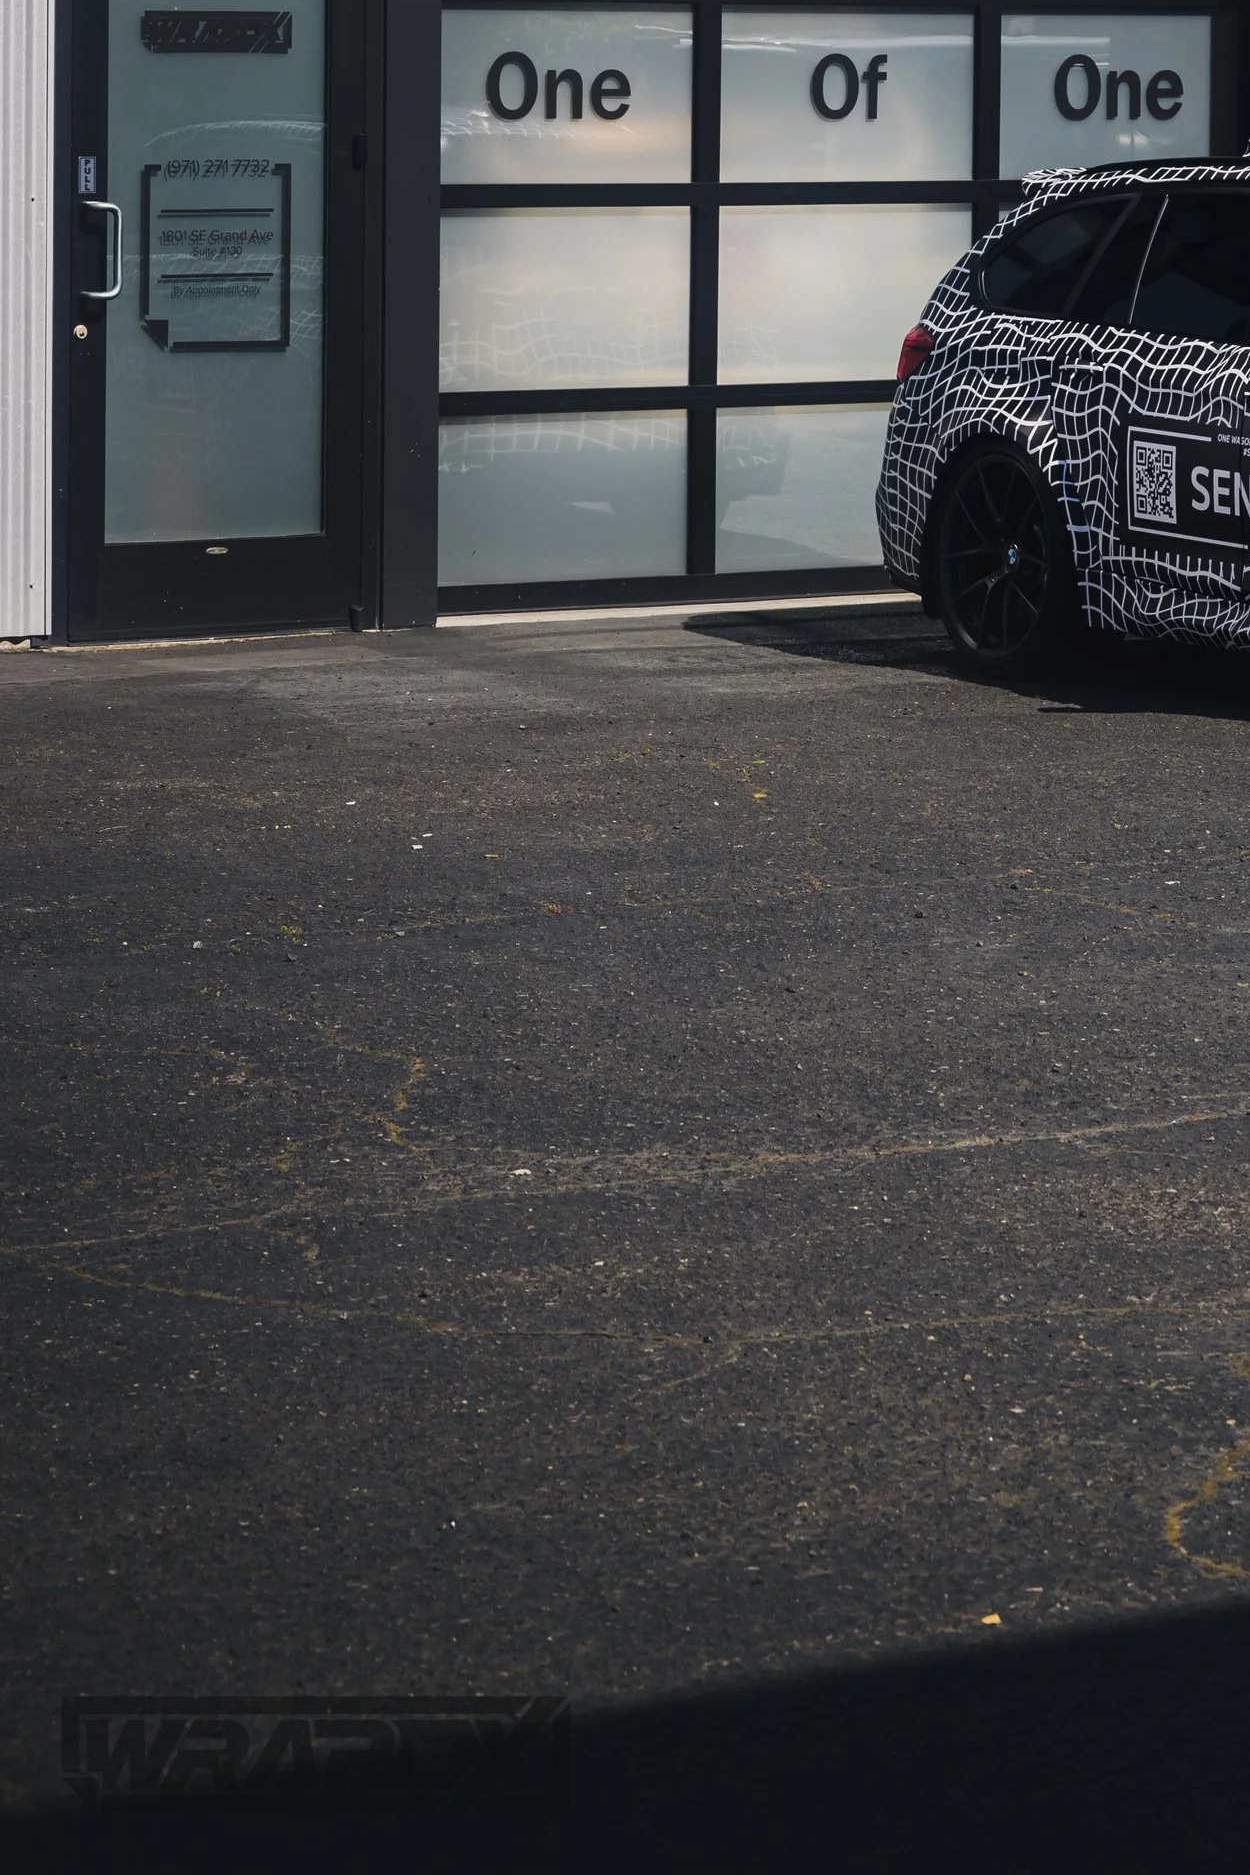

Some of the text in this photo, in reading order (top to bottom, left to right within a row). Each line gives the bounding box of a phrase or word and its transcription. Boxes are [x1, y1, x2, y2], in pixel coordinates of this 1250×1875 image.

[485, 51, 1184, 122] One Of One
[165, 158, 270, 178] (971) 271 7732
[161, 229, 274, 243] 1801 SE Grand Ave
[192, 246, 217, 256] Suite
[173, 285, 262, 296] By Appointment Only
[1217, 434, 1231, 444] ONE
